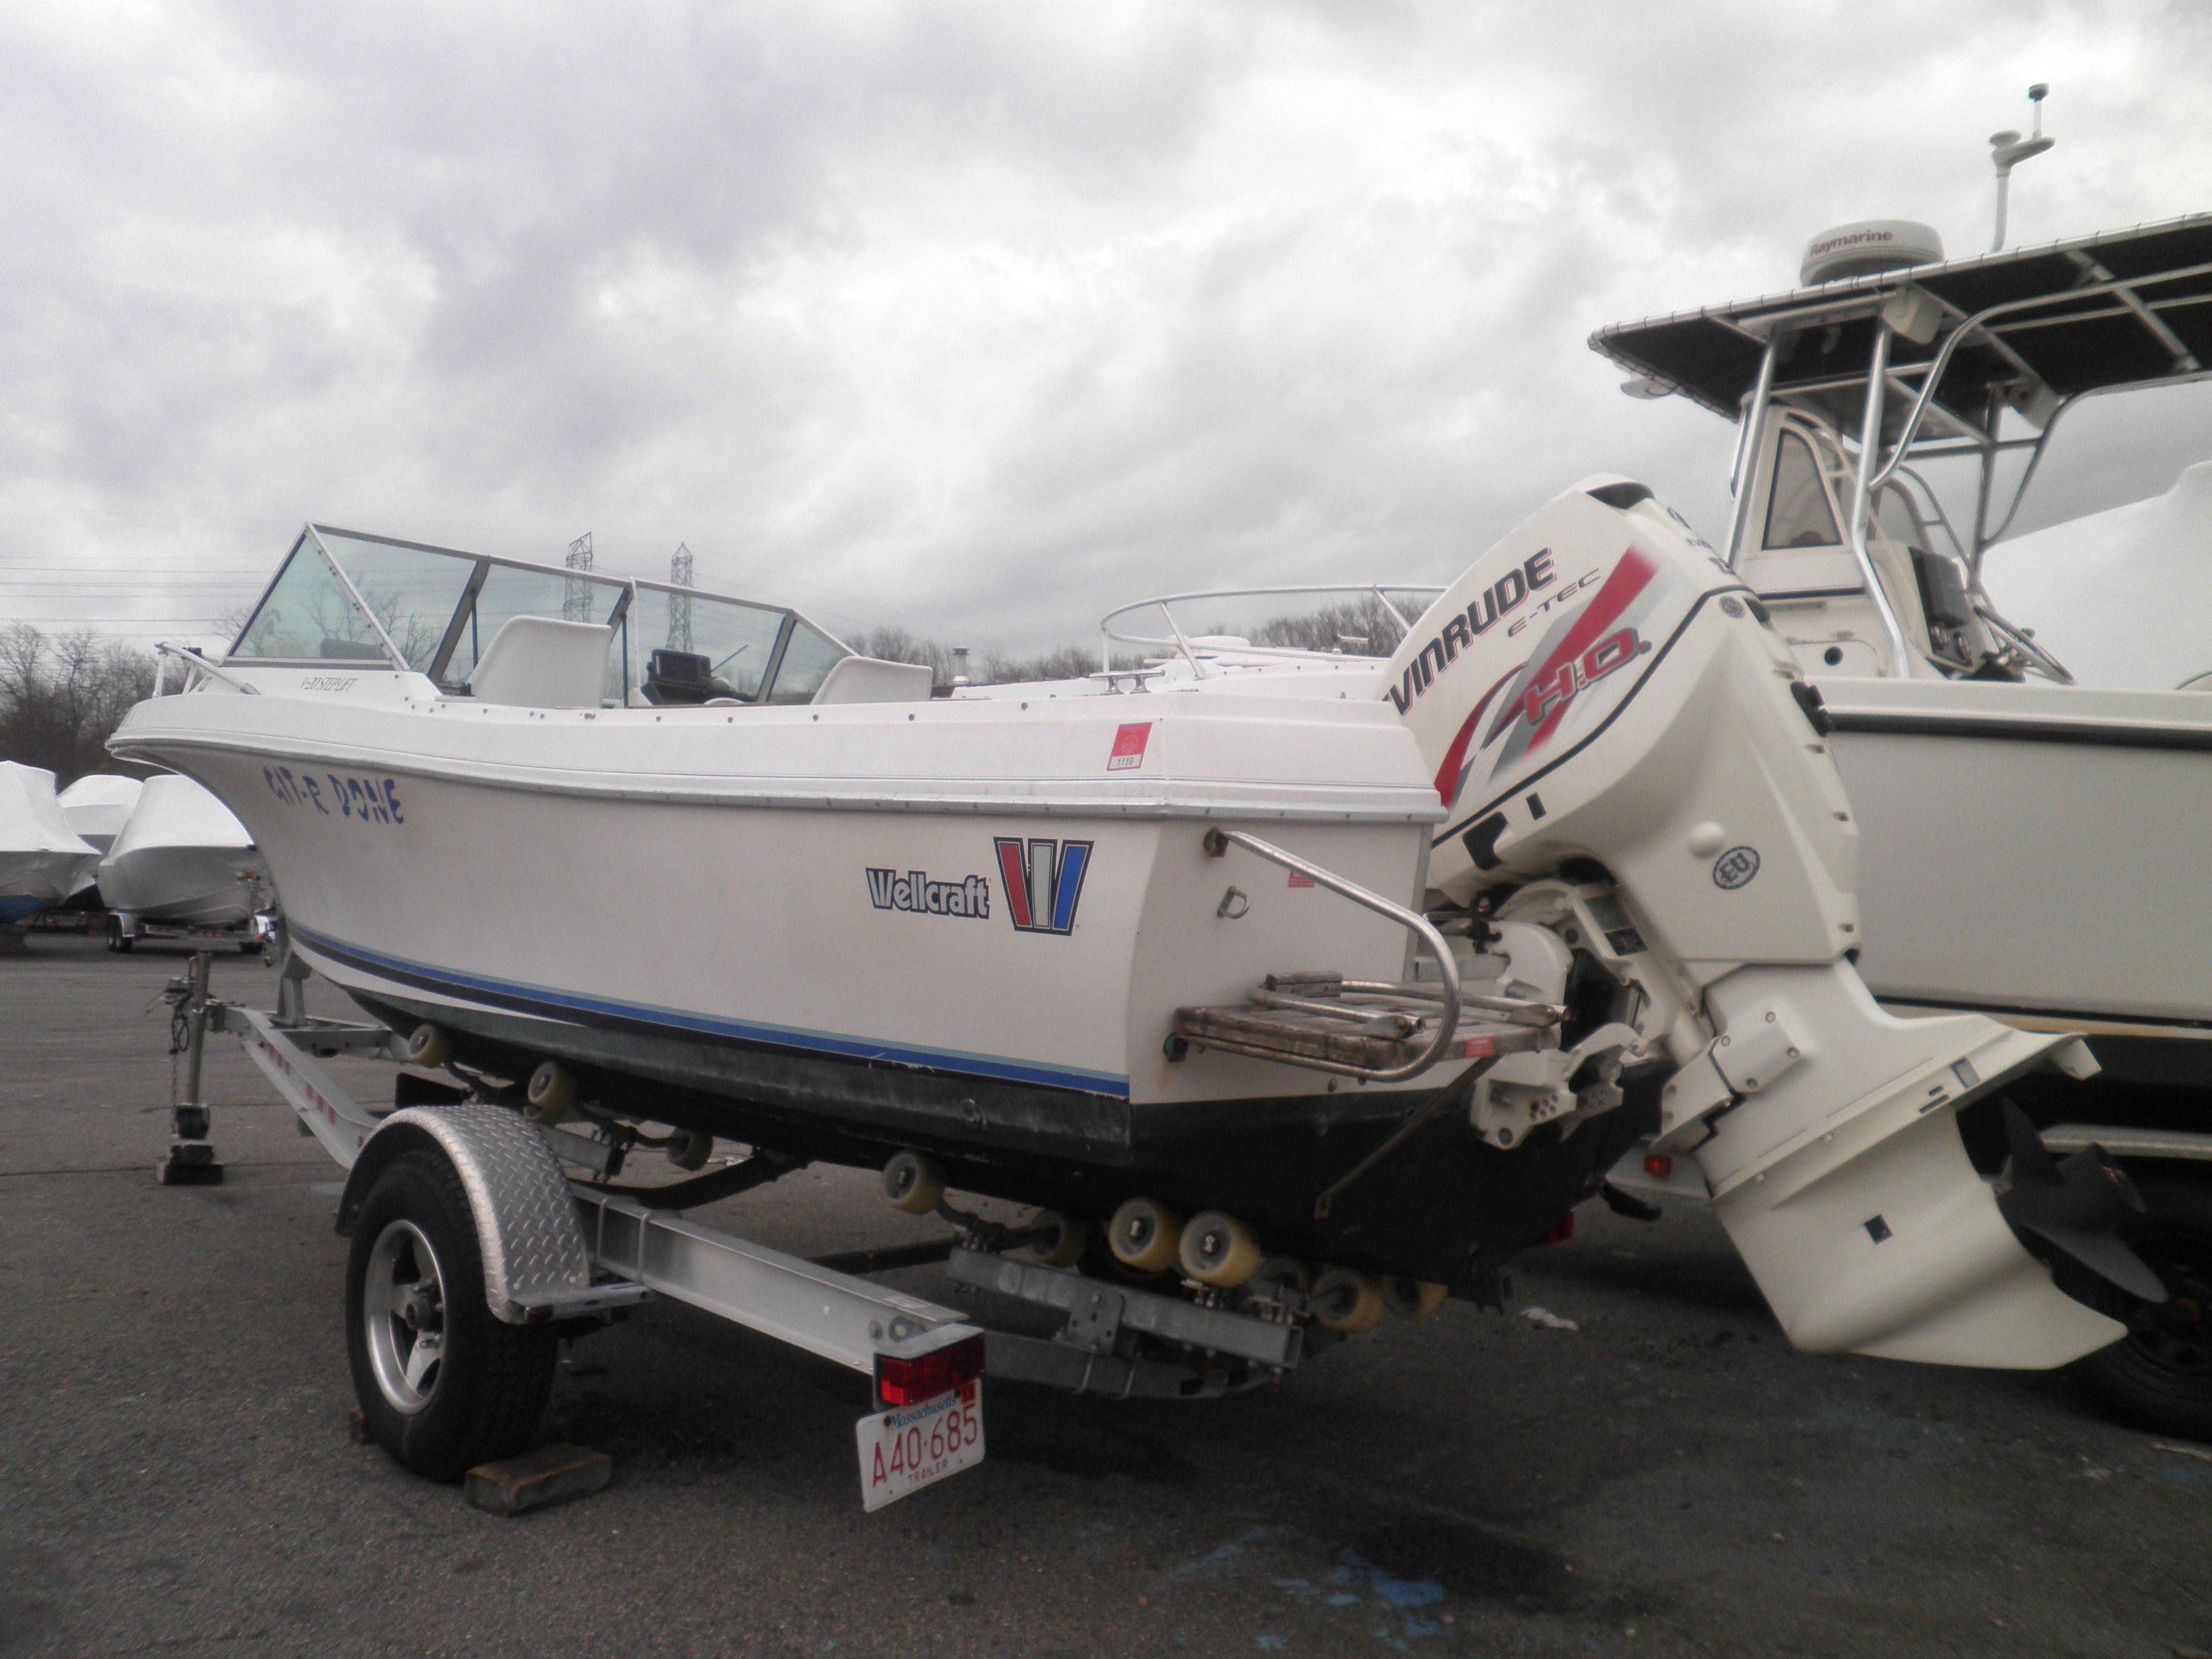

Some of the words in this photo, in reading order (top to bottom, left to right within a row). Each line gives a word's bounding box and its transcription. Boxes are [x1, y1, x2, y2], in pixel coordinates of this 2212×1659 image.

[1507, 567, 1601, 638] E-TEC
[1382, 547, 1559, 717] VINRUDE
[1117, 757, 1134, 767] 1119
[326, 774, 404, 825] DONE
[866, 868, 990, 919] Wellcraft
[891, 1396, 956, 1429] Massachusetts
[908, 1459, 948, 1484] TRAILER
